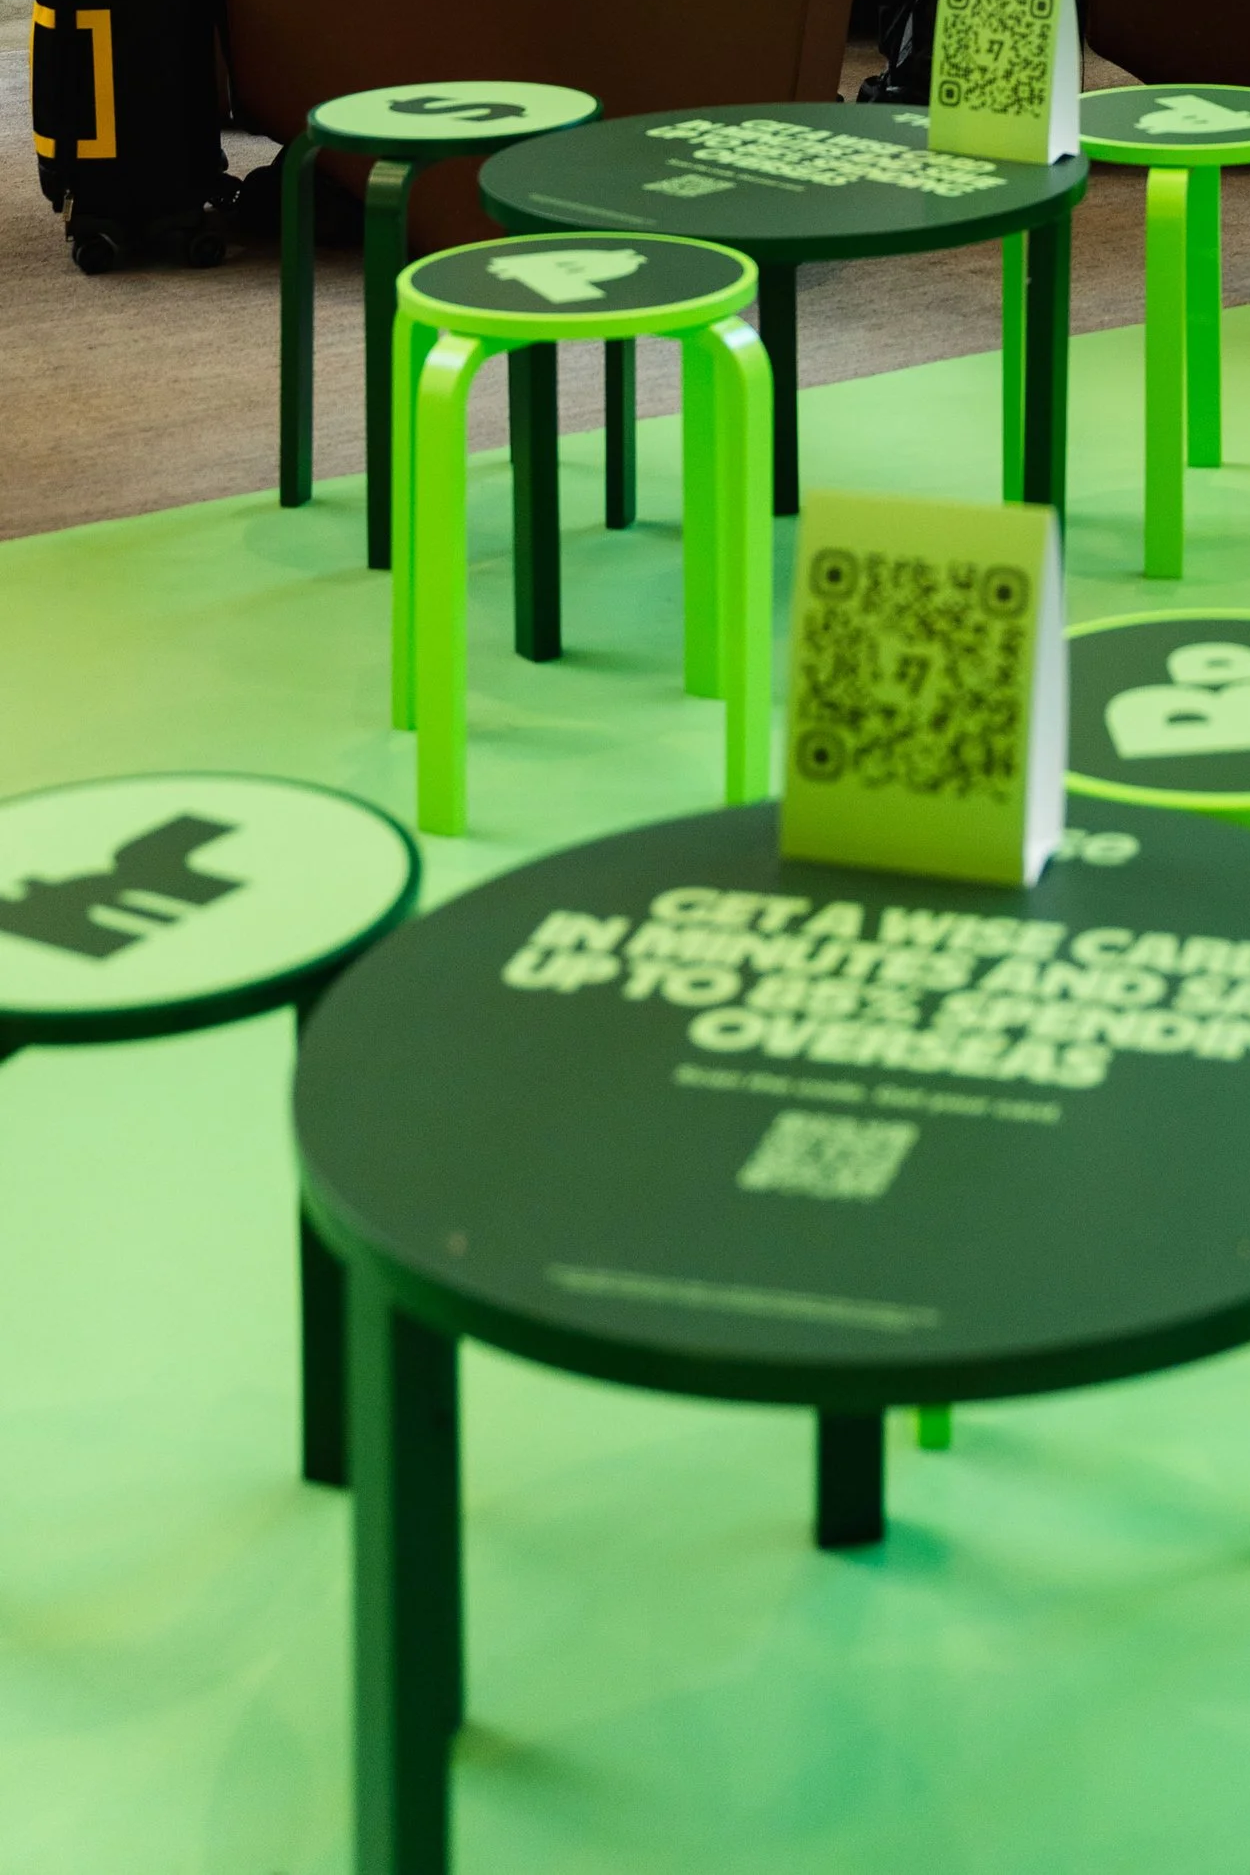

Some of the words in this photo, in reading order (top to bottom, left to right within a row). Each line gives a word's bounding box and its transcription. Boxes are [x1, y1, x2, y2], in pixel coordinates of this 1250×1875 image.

[530, 909, 633, 954] IN
[623, 921, 979, 991] MINUTES
[980, 955, 1168, 1007] AND
[649, 886, 812, 933] GET
[803, 900, 867, 939] A
[877, 906, 1066, 961] WISE
[502, 945, 621, 994] UP
[623, 962, 742, 1007] TO
[687, 1006, 1112, 1090] OVERSEAS
